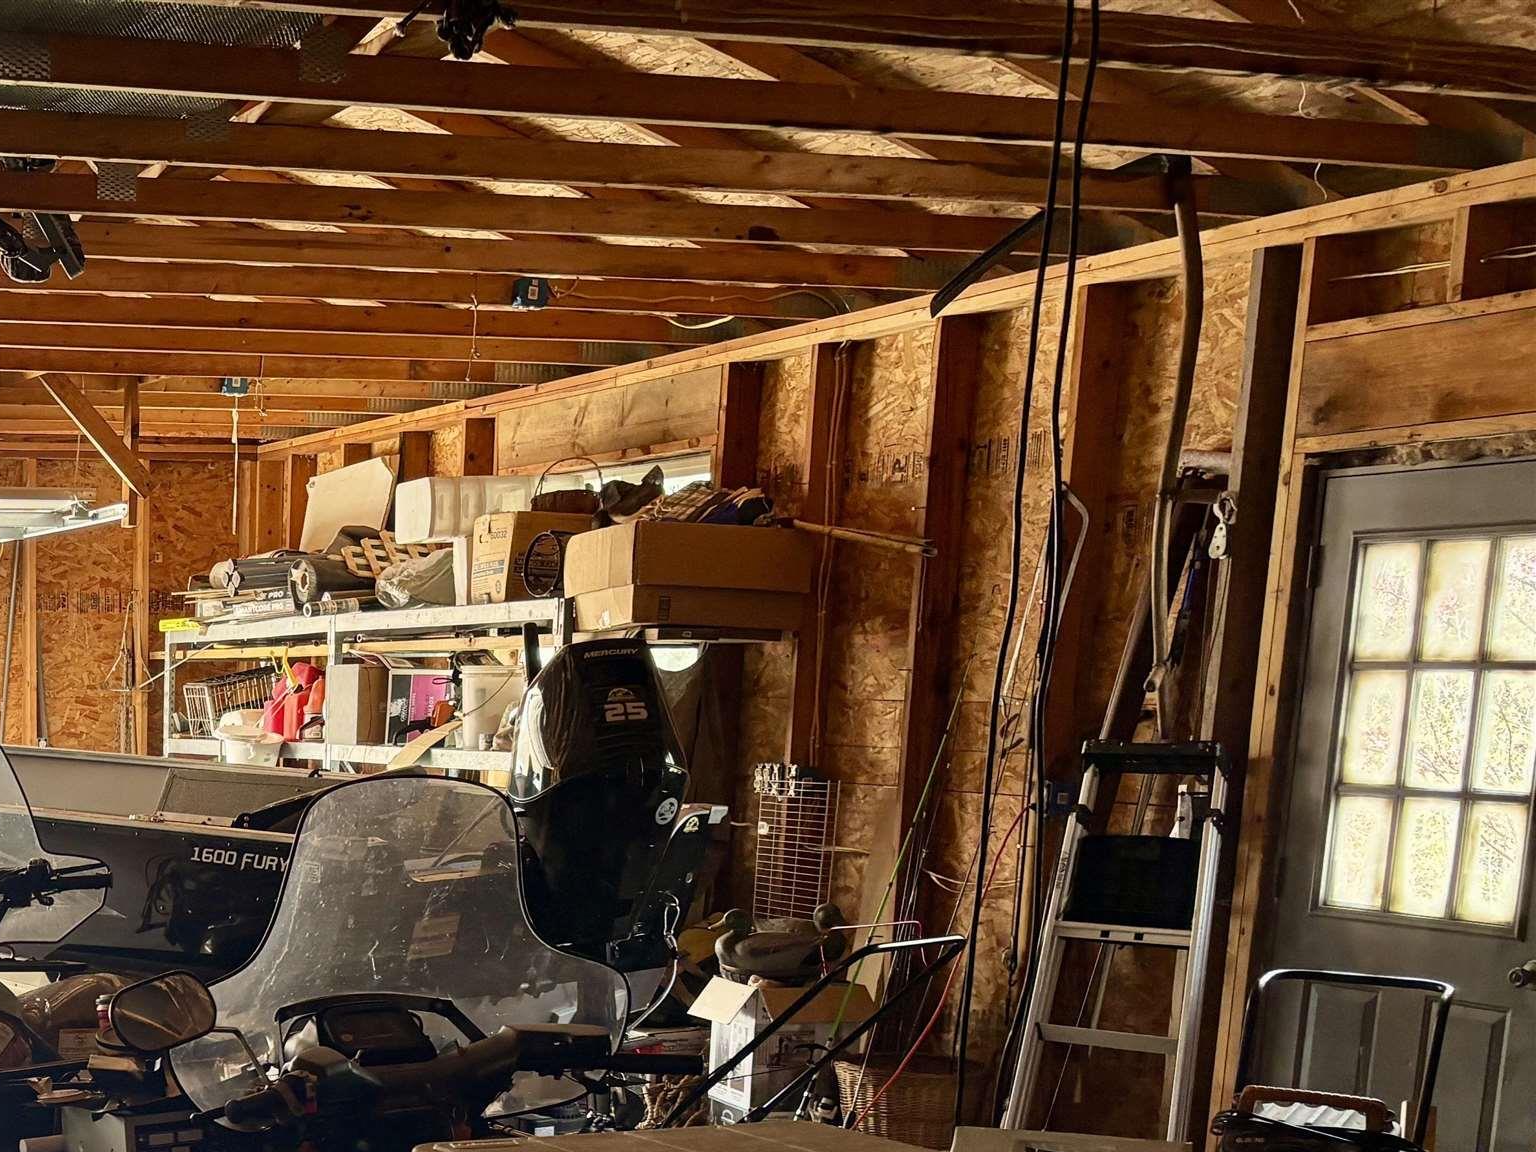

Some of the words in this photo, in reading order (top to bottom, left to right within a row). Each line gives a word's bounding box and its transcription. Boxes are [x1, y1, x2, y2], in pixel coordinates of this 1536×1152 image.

[583, 648, 639, 659] MERCURY
[604, 702, 648, 722] 25
[190, 846, 237, 867] 1600
[240, 852, 289, 873] FURY
